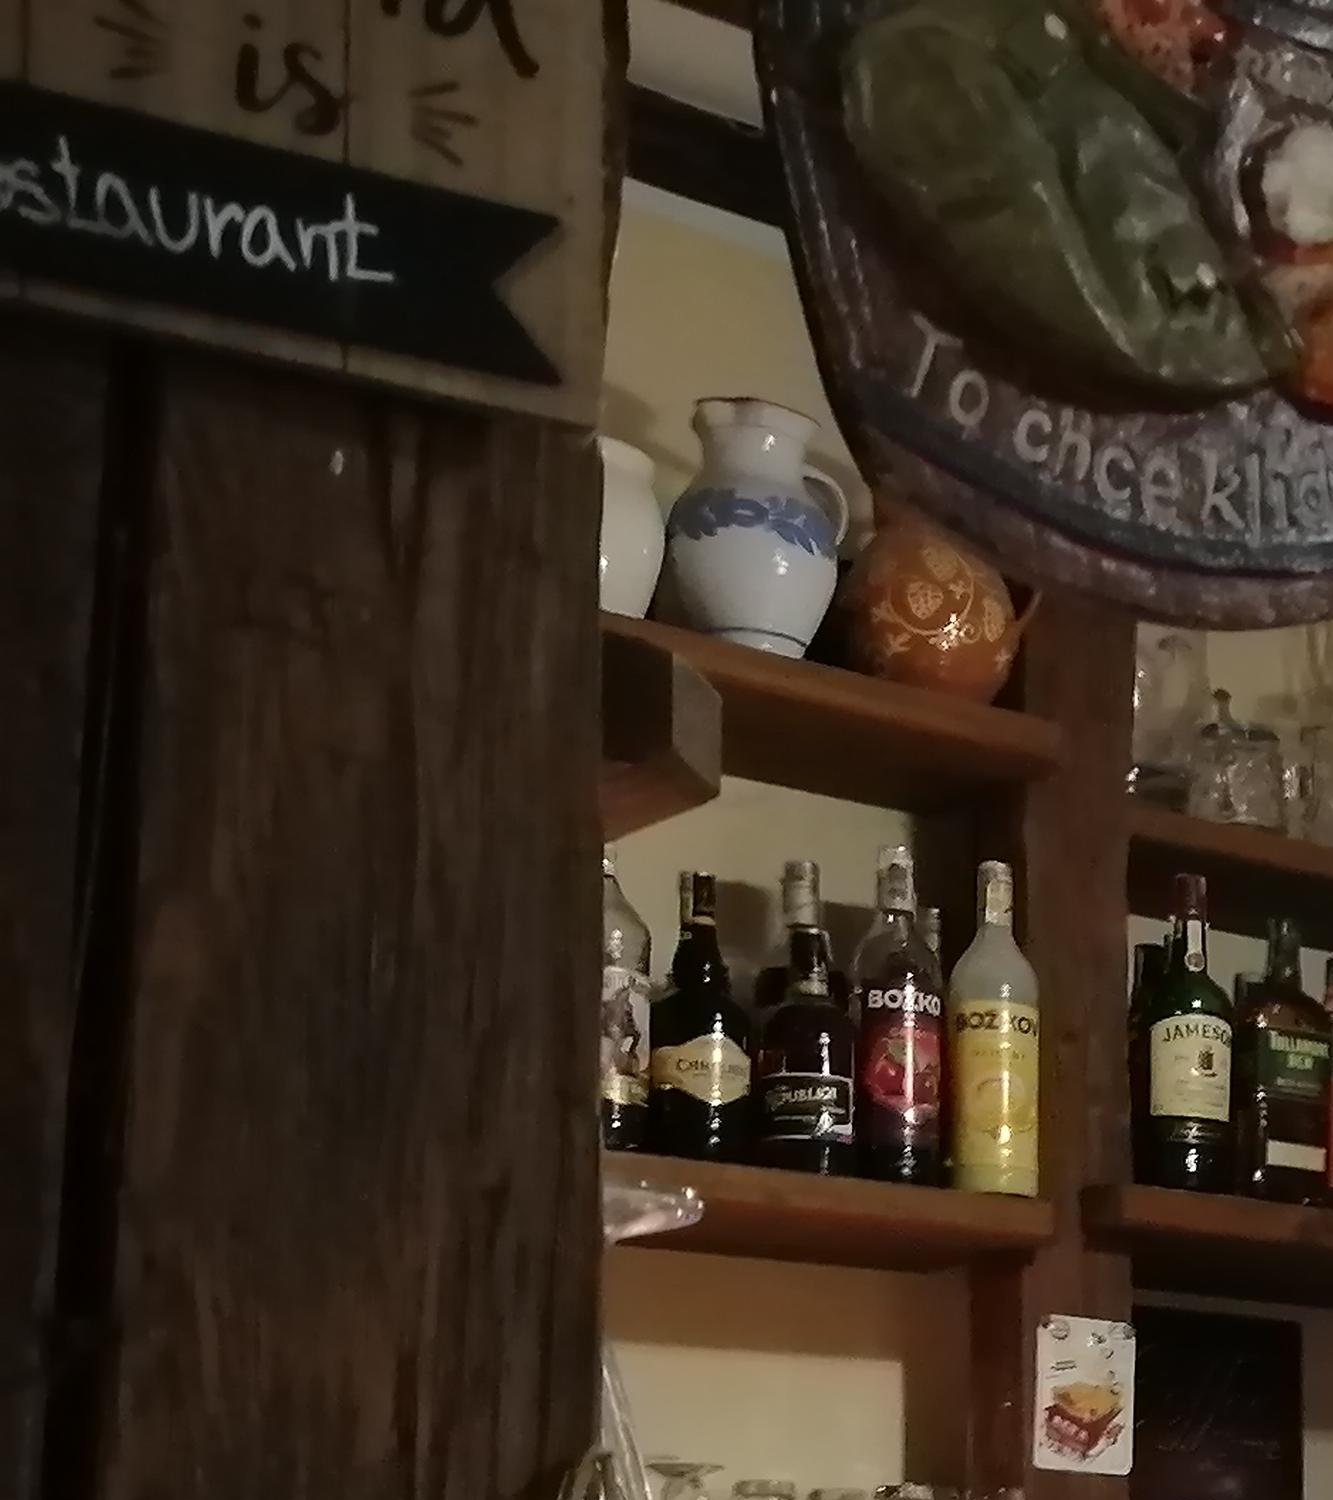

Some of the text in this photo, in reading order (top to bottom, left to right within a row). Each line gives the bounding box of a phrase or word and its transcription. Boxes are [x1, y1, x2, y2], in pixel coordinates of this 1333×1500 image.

[235, 14, 346, 135] is
[0, 136, 396, 284] staurant
[1012, 400, 1185, 526] chce
